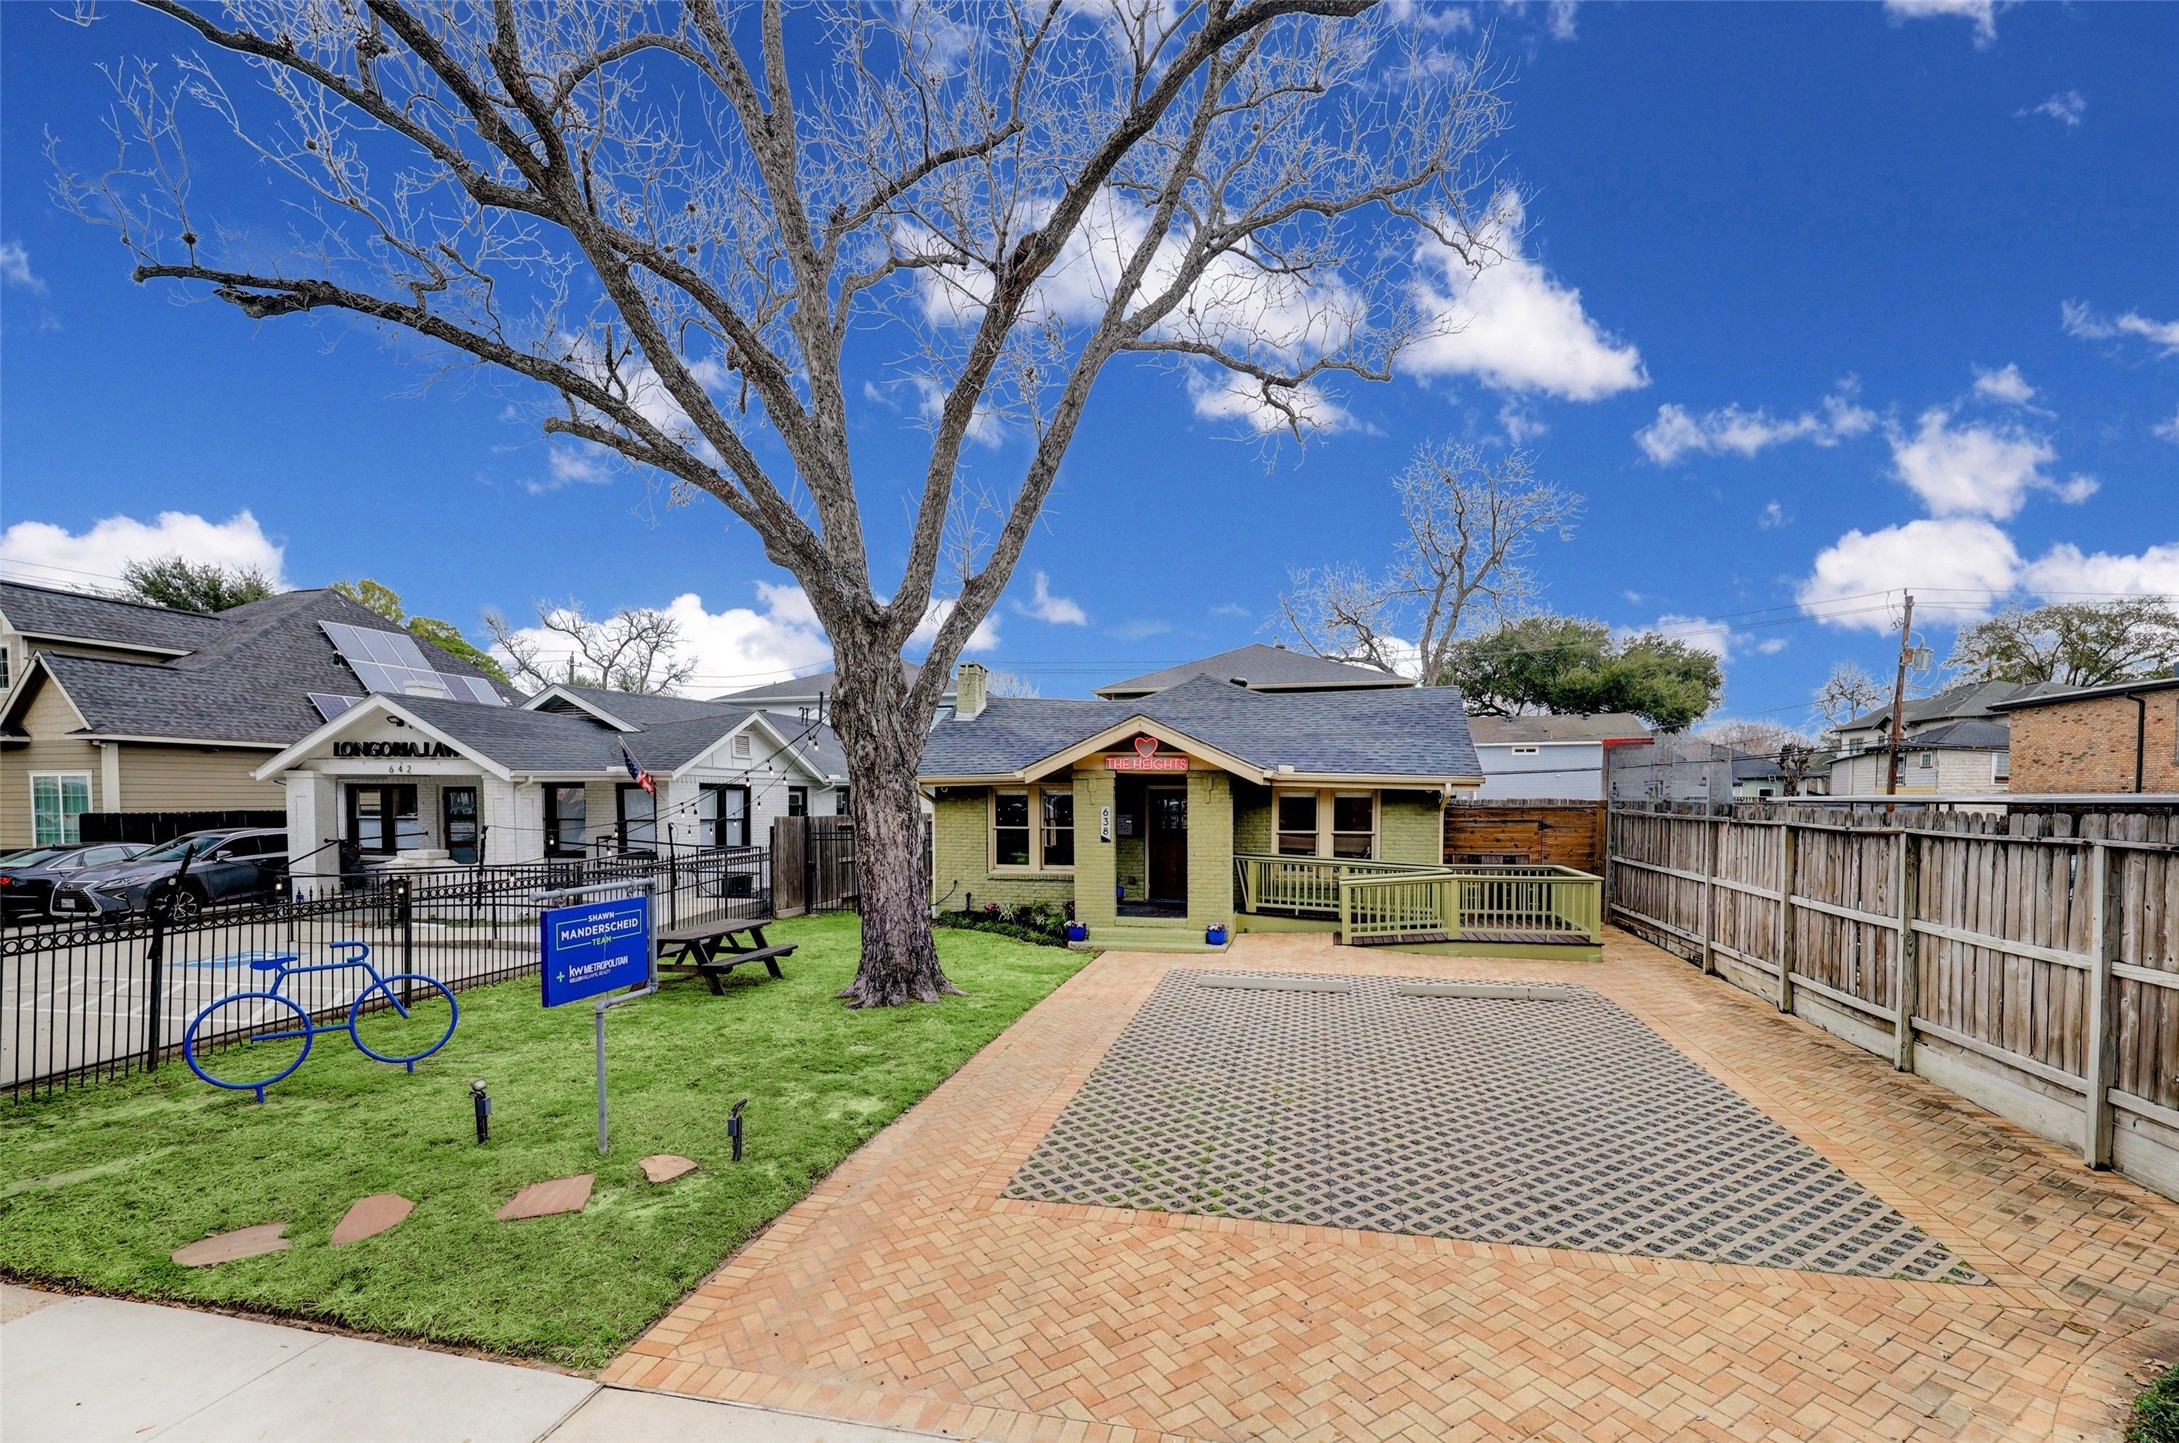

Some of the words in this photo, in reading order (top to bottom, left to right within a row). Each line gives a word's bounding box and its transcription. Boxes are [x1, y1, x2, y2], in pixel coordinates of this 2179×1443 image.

[333, 741, 420, 758] LONGORIA
[388, 764, 412, 774] 642
[1105, 758, 1130, 770] THE
[1133, 758, 1187, 770] HEIGHTS
[588, 911, 615, 923] SHAWN
[561, 918, 638, 941] MANDERSCHEID
[592, 936, 612, 946] TEAM
